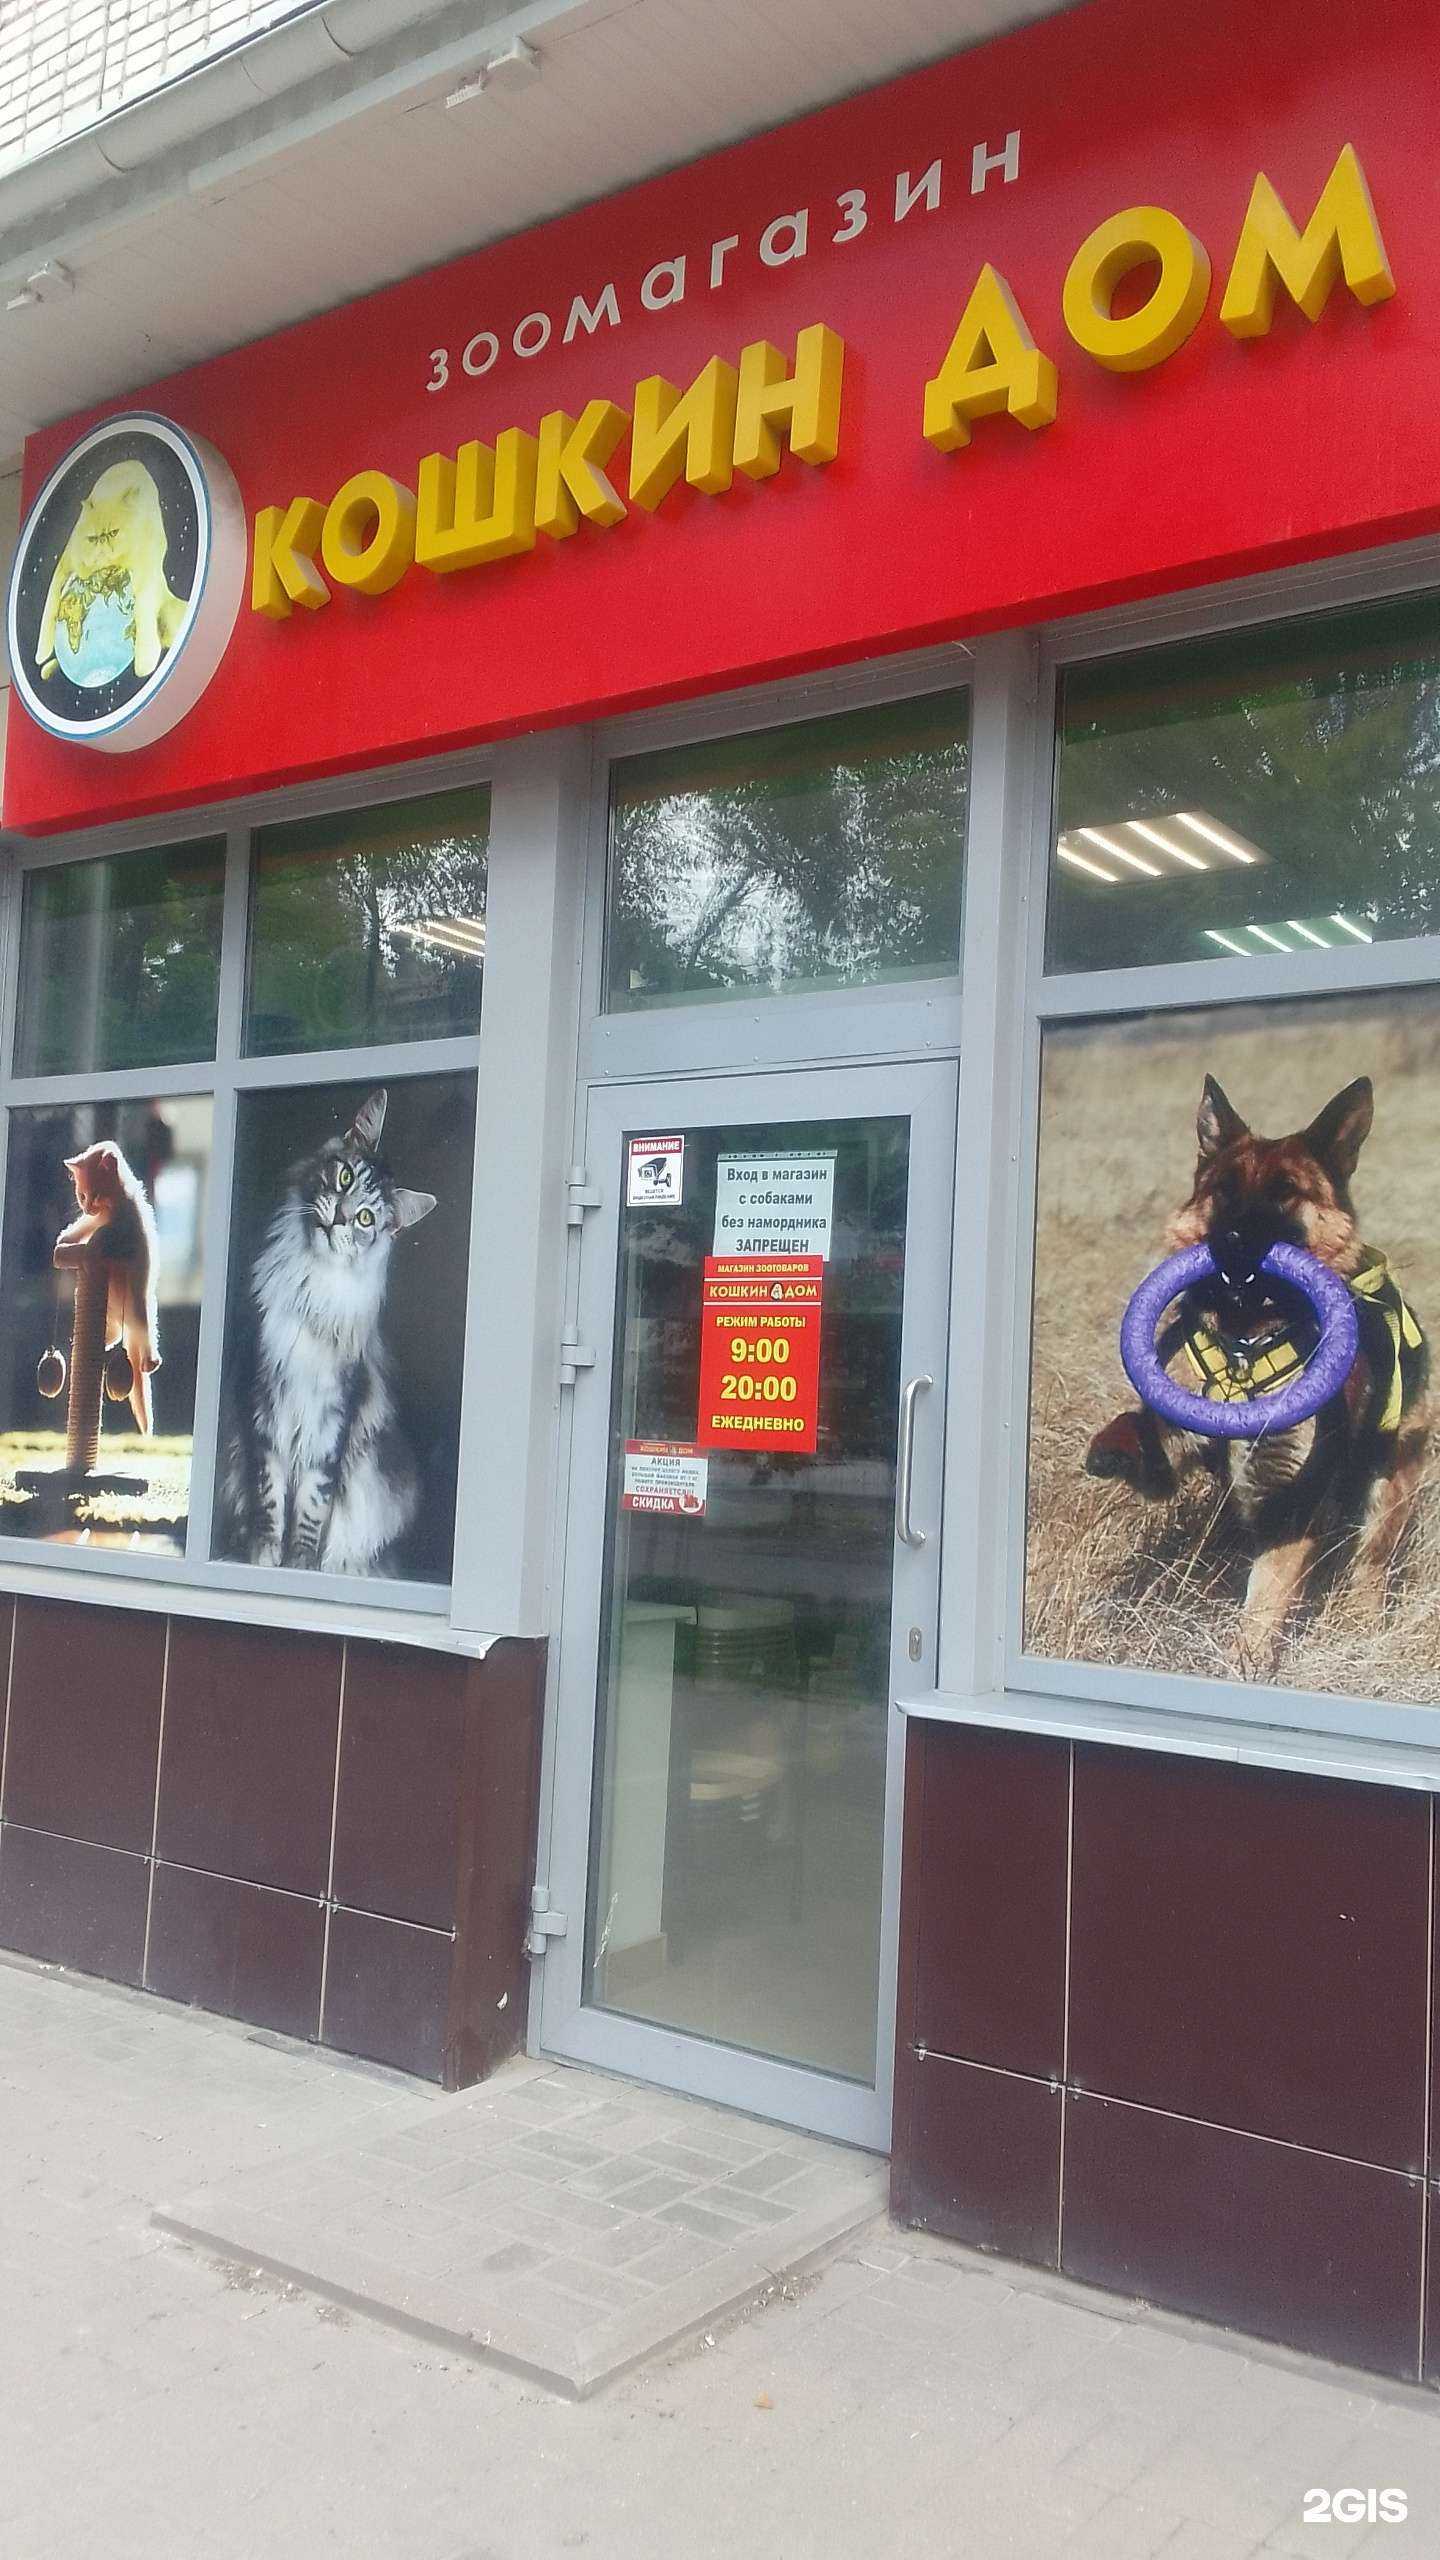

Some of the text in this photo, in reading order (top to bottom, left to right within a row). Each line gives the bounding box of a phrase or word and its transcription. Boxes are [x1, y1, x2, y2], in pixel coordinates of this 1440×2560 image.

[250, 141, 1396, 620] КОШКИН ДОМ
[633, 1140, 680, 1152] ВНИМАНИЕ
[727, 1168, 827, 1182] Вход в магазин
[739, 1190, 813, 1205] с собаками
[721, 1215, 827, 1232] без намордника
[735, 1239, 809, 1254] ЗАПРЕЩЕН
[717, 1263, 809, 1273] МАГАЗИН ЗООТОВАРОВ
[709, 1284, 817, 1298] КОШКИН ДОМ
[716, 1316, 806, 1328] РЕЖИМ РАБОТЫ
[731, 1338, 790, 1363] 9:00
[720, 1375, 797, 1402] 20:00
[711, 1415, 805, 1432] ЕЖЕДНЕВНО
[651, 1457, 681, 1466] АКЦИЯ
[632, 1496, 675, 1511] СКИДКА
